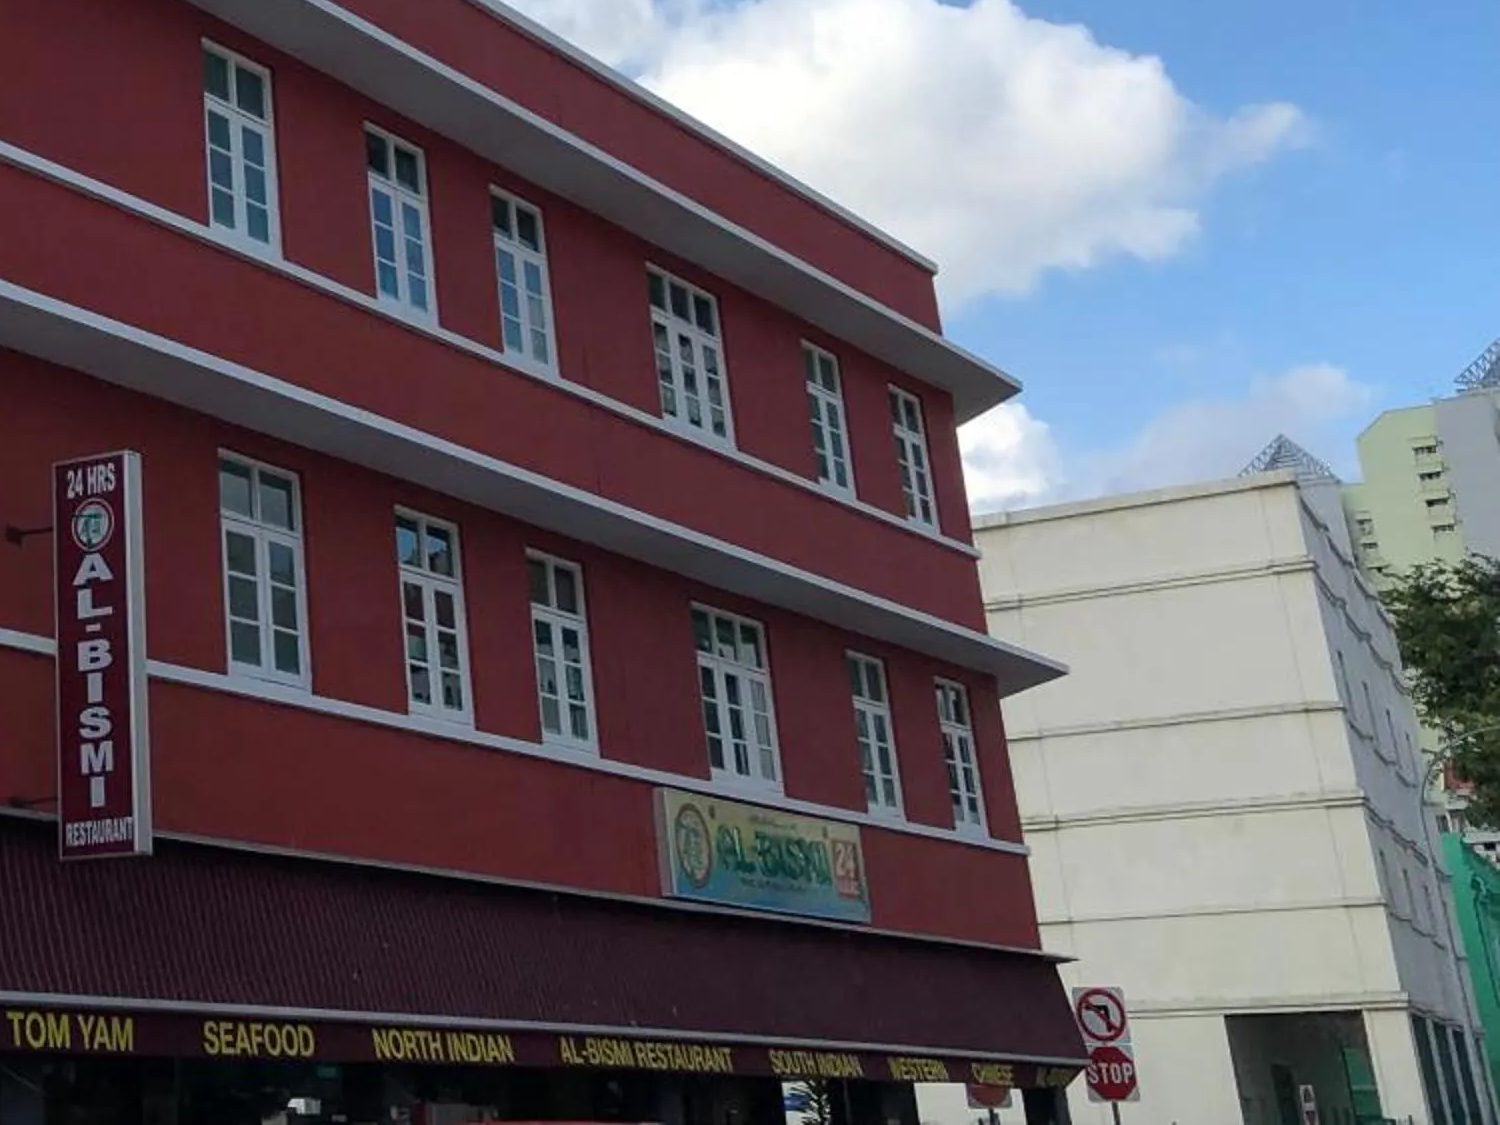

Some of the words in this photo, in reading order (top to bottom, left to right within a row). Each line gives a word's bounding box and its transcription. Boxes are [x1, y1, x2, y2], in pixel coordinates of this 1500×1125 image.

[67, 468, 83, 499] 24
[87, 462, 116, 495] HRS
[73, 552, 115, 808] AL-BISMI
[66, 816, 134, 847] RESTAURANT
[7, 1011, 71, 1050] TOM
[77, 1014, 134, 1052] YAM
[202, 1020, 315, 1057] SEAFOOD
[371, 1028, 444, 1061] NORTH
[445, 1032, 515, 1063] INDIAN
[560, 1036, 634, 1066] AL-BISMI
[634, 1042, 734, 1072] RESTAURANT
[1087, 1063, 1133, 1084] STOP
